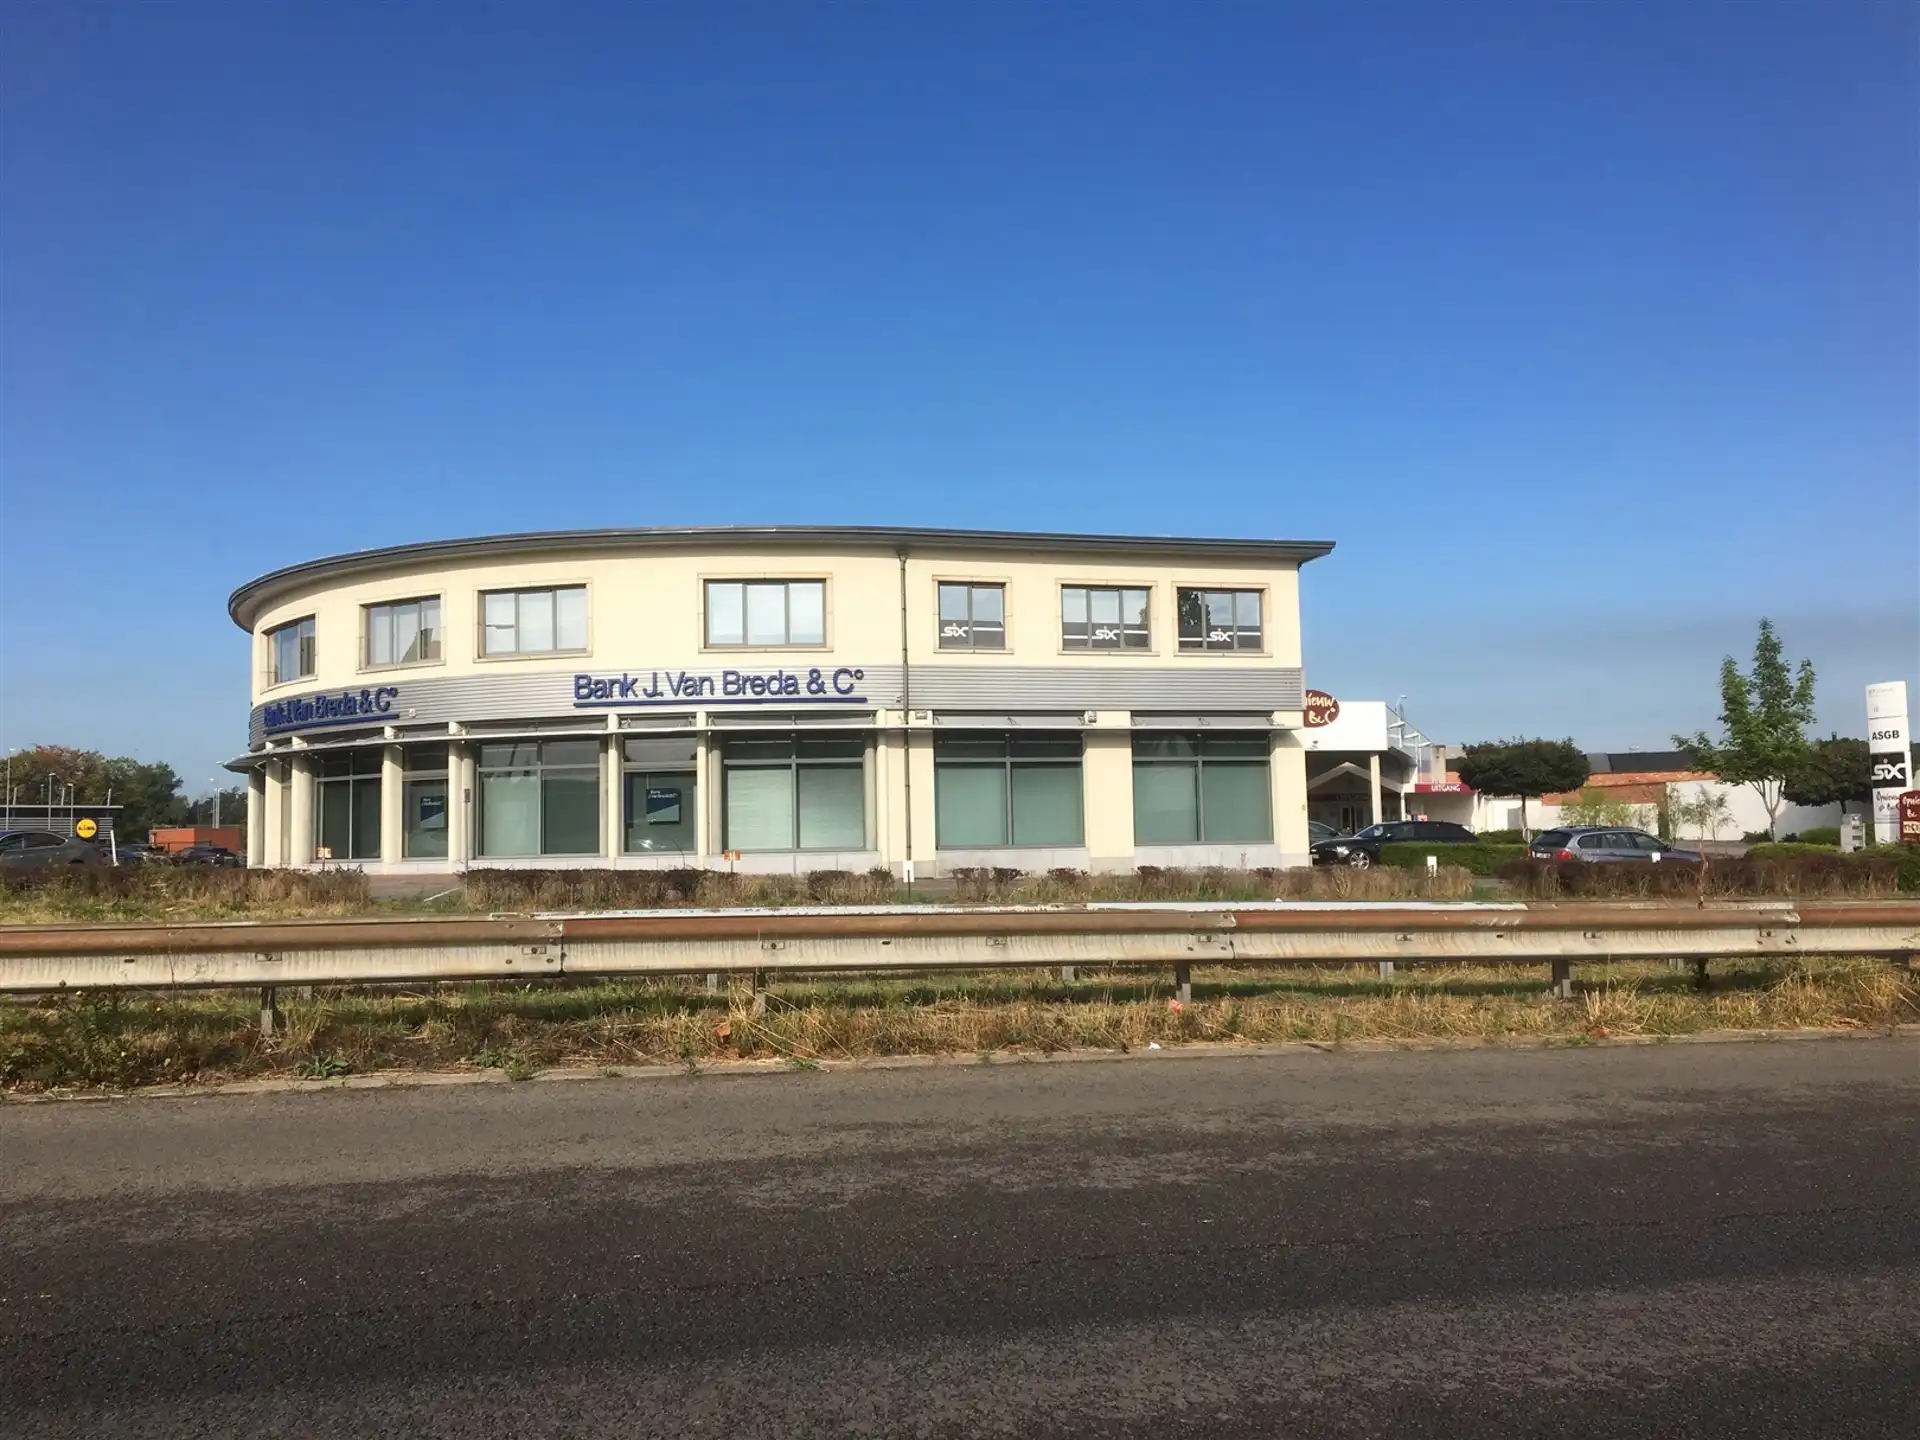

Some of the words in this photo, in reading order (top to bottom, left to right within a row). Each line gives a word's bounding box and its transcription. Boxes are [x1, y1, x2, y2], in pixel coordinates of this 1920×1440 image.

[574, 672, 638, 699] Bank
[722, 669, 800, 695] Breda
[806, 668, 827, 695] &
[315, 692, 356, 719] Breda
[357, 689, 373, 714] &
[1872, 730, 1900, 740] ASGB
